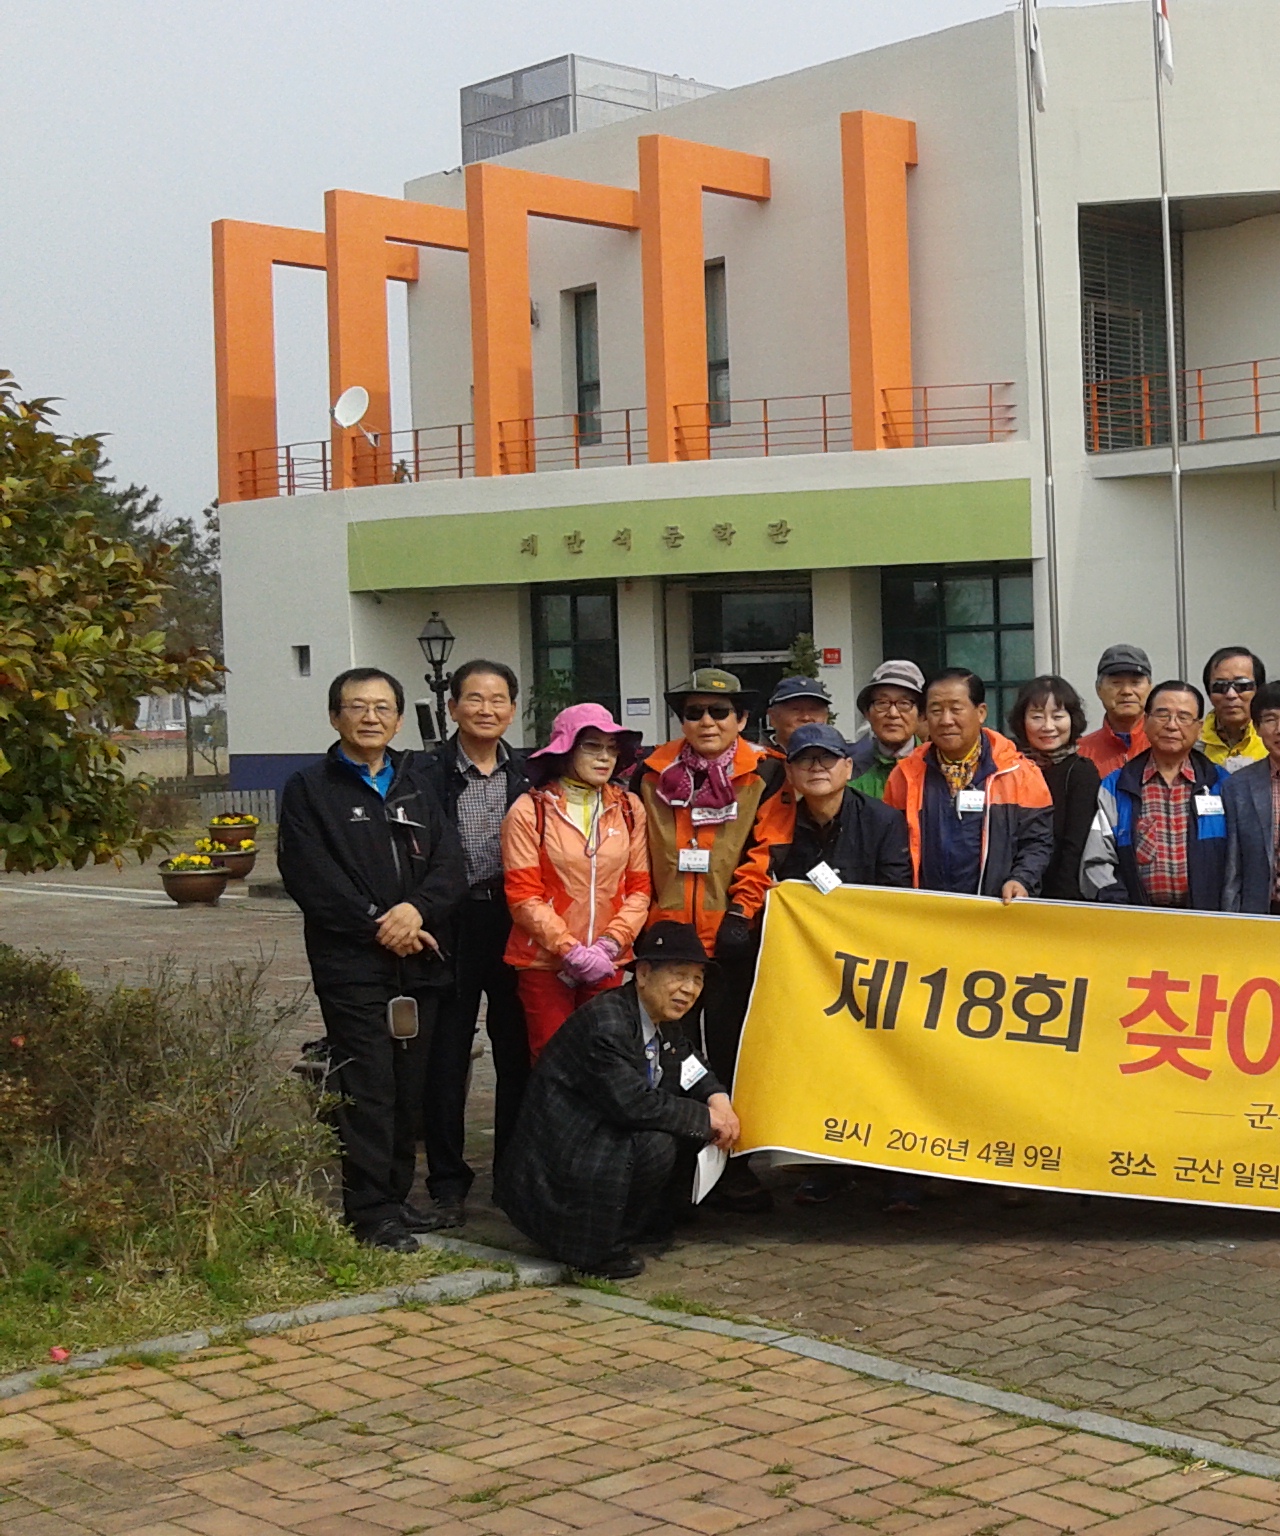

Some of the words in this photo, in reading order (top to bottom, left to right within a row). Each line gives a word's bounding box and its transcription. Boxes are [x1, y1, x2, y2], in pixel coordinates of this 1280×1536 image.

[520, 519, 792, 556] 채만식문학관
[823, 950, 1089, 1053] 제18회
[823, 1117, 872, 1148] 일시
[886, 1127, 969, 1163] 2016년
[976, 1140, 1017, 1168] 4월
[1024, 1145, 1063, 1172] 9일
[1108, 1150, 1157, 1178] 장소
[1173, 1154, 1224, 1184] 군산
[1231, 1161, 1280, 1191] 일원
